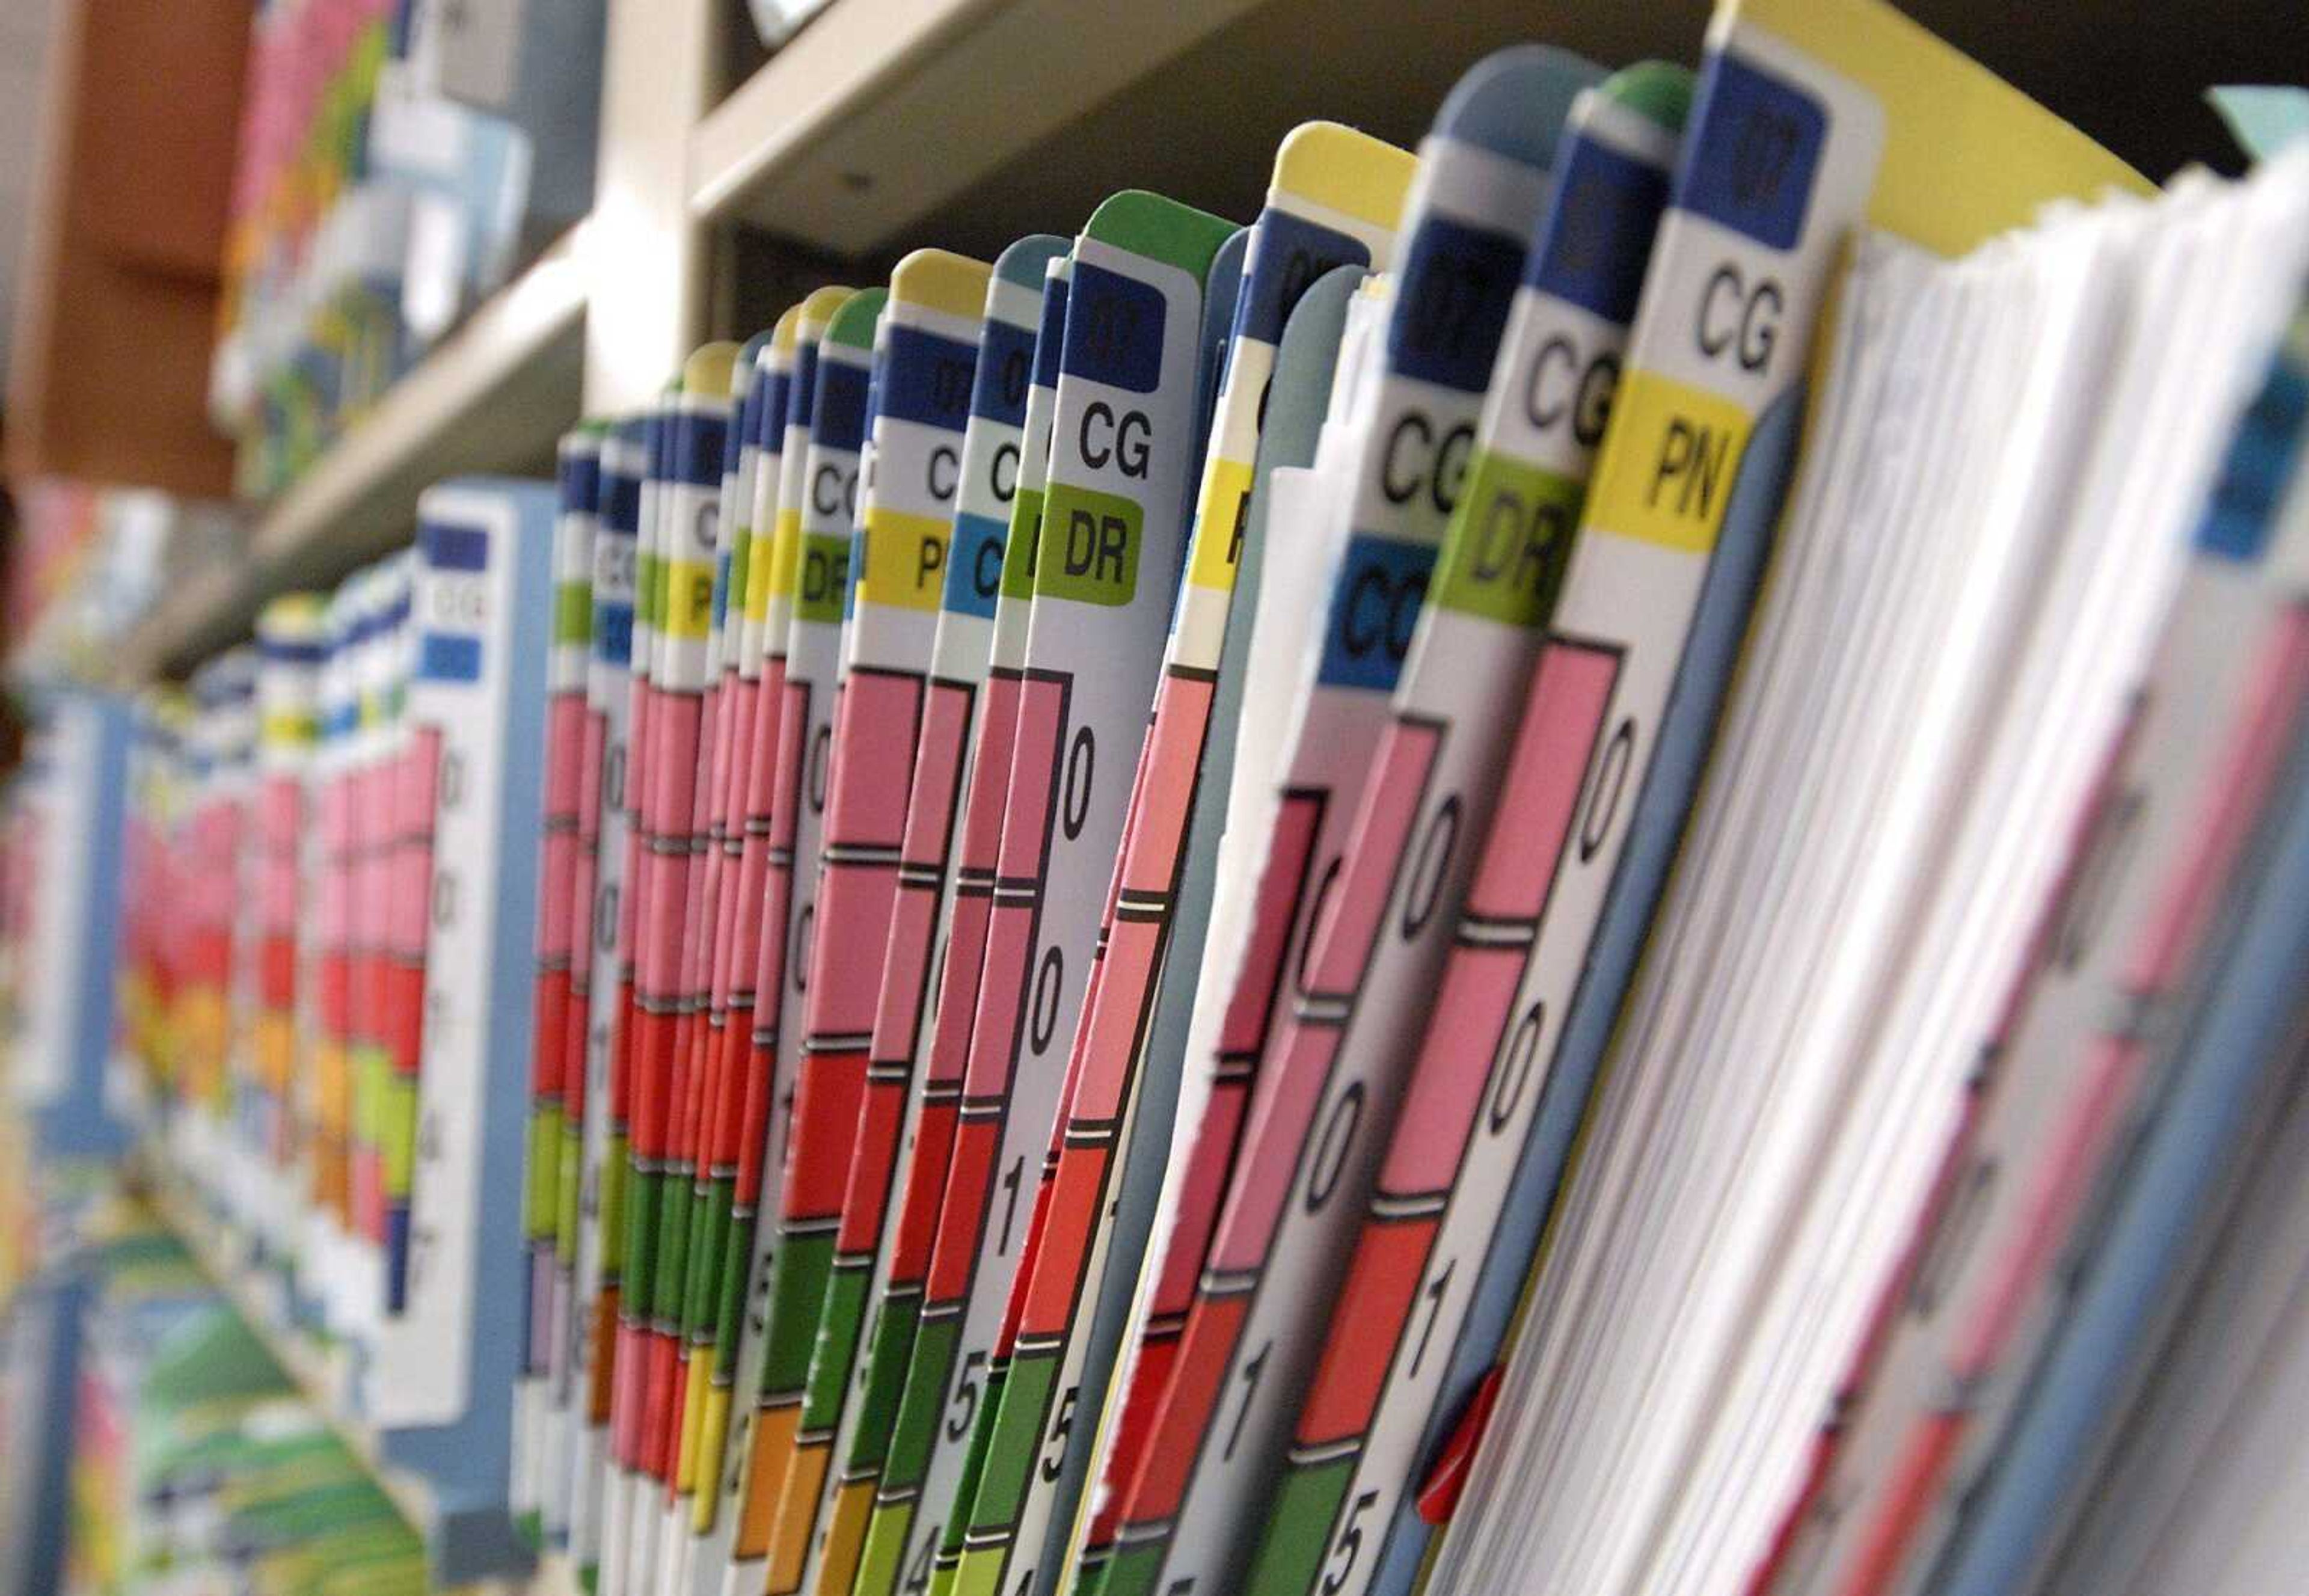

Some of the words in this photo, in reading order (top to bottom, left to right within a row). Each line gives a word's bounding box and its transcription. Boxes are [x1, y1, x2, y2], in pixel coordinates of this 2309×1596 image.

[1696, 263, 1785, 372] CG
[928, 447, 958, 500] C
[992, 443, 1020, 502] C
[1081, 401, 1153, 480] CG
[1648, 416, 1735, 523] PN
[916, 537, 943, 589] P
[1064, 509, 1129, 583] DR
[1471, 489, 1565, 599] DR
[1064, 725, 1094, 841] 0
[1581, 718, 1636, 864] 0
[1403, 793, 1463, 944] 0
[1031, 945, 1064, 1056] 0
[1492, 1001, 1543, 1136] 0
[1307, 1081, 1364, 1214] 0
[996, 1155, 1026, 1256] 1
[1409, 1259, 1457, 1381] 1
[947, 1351, 987, 1443] 5
[1224, 1340, 1272, 1462] 1
[906, 1526, 940, 1596] 4
[1323, 1490, 1381, 1596] 5
